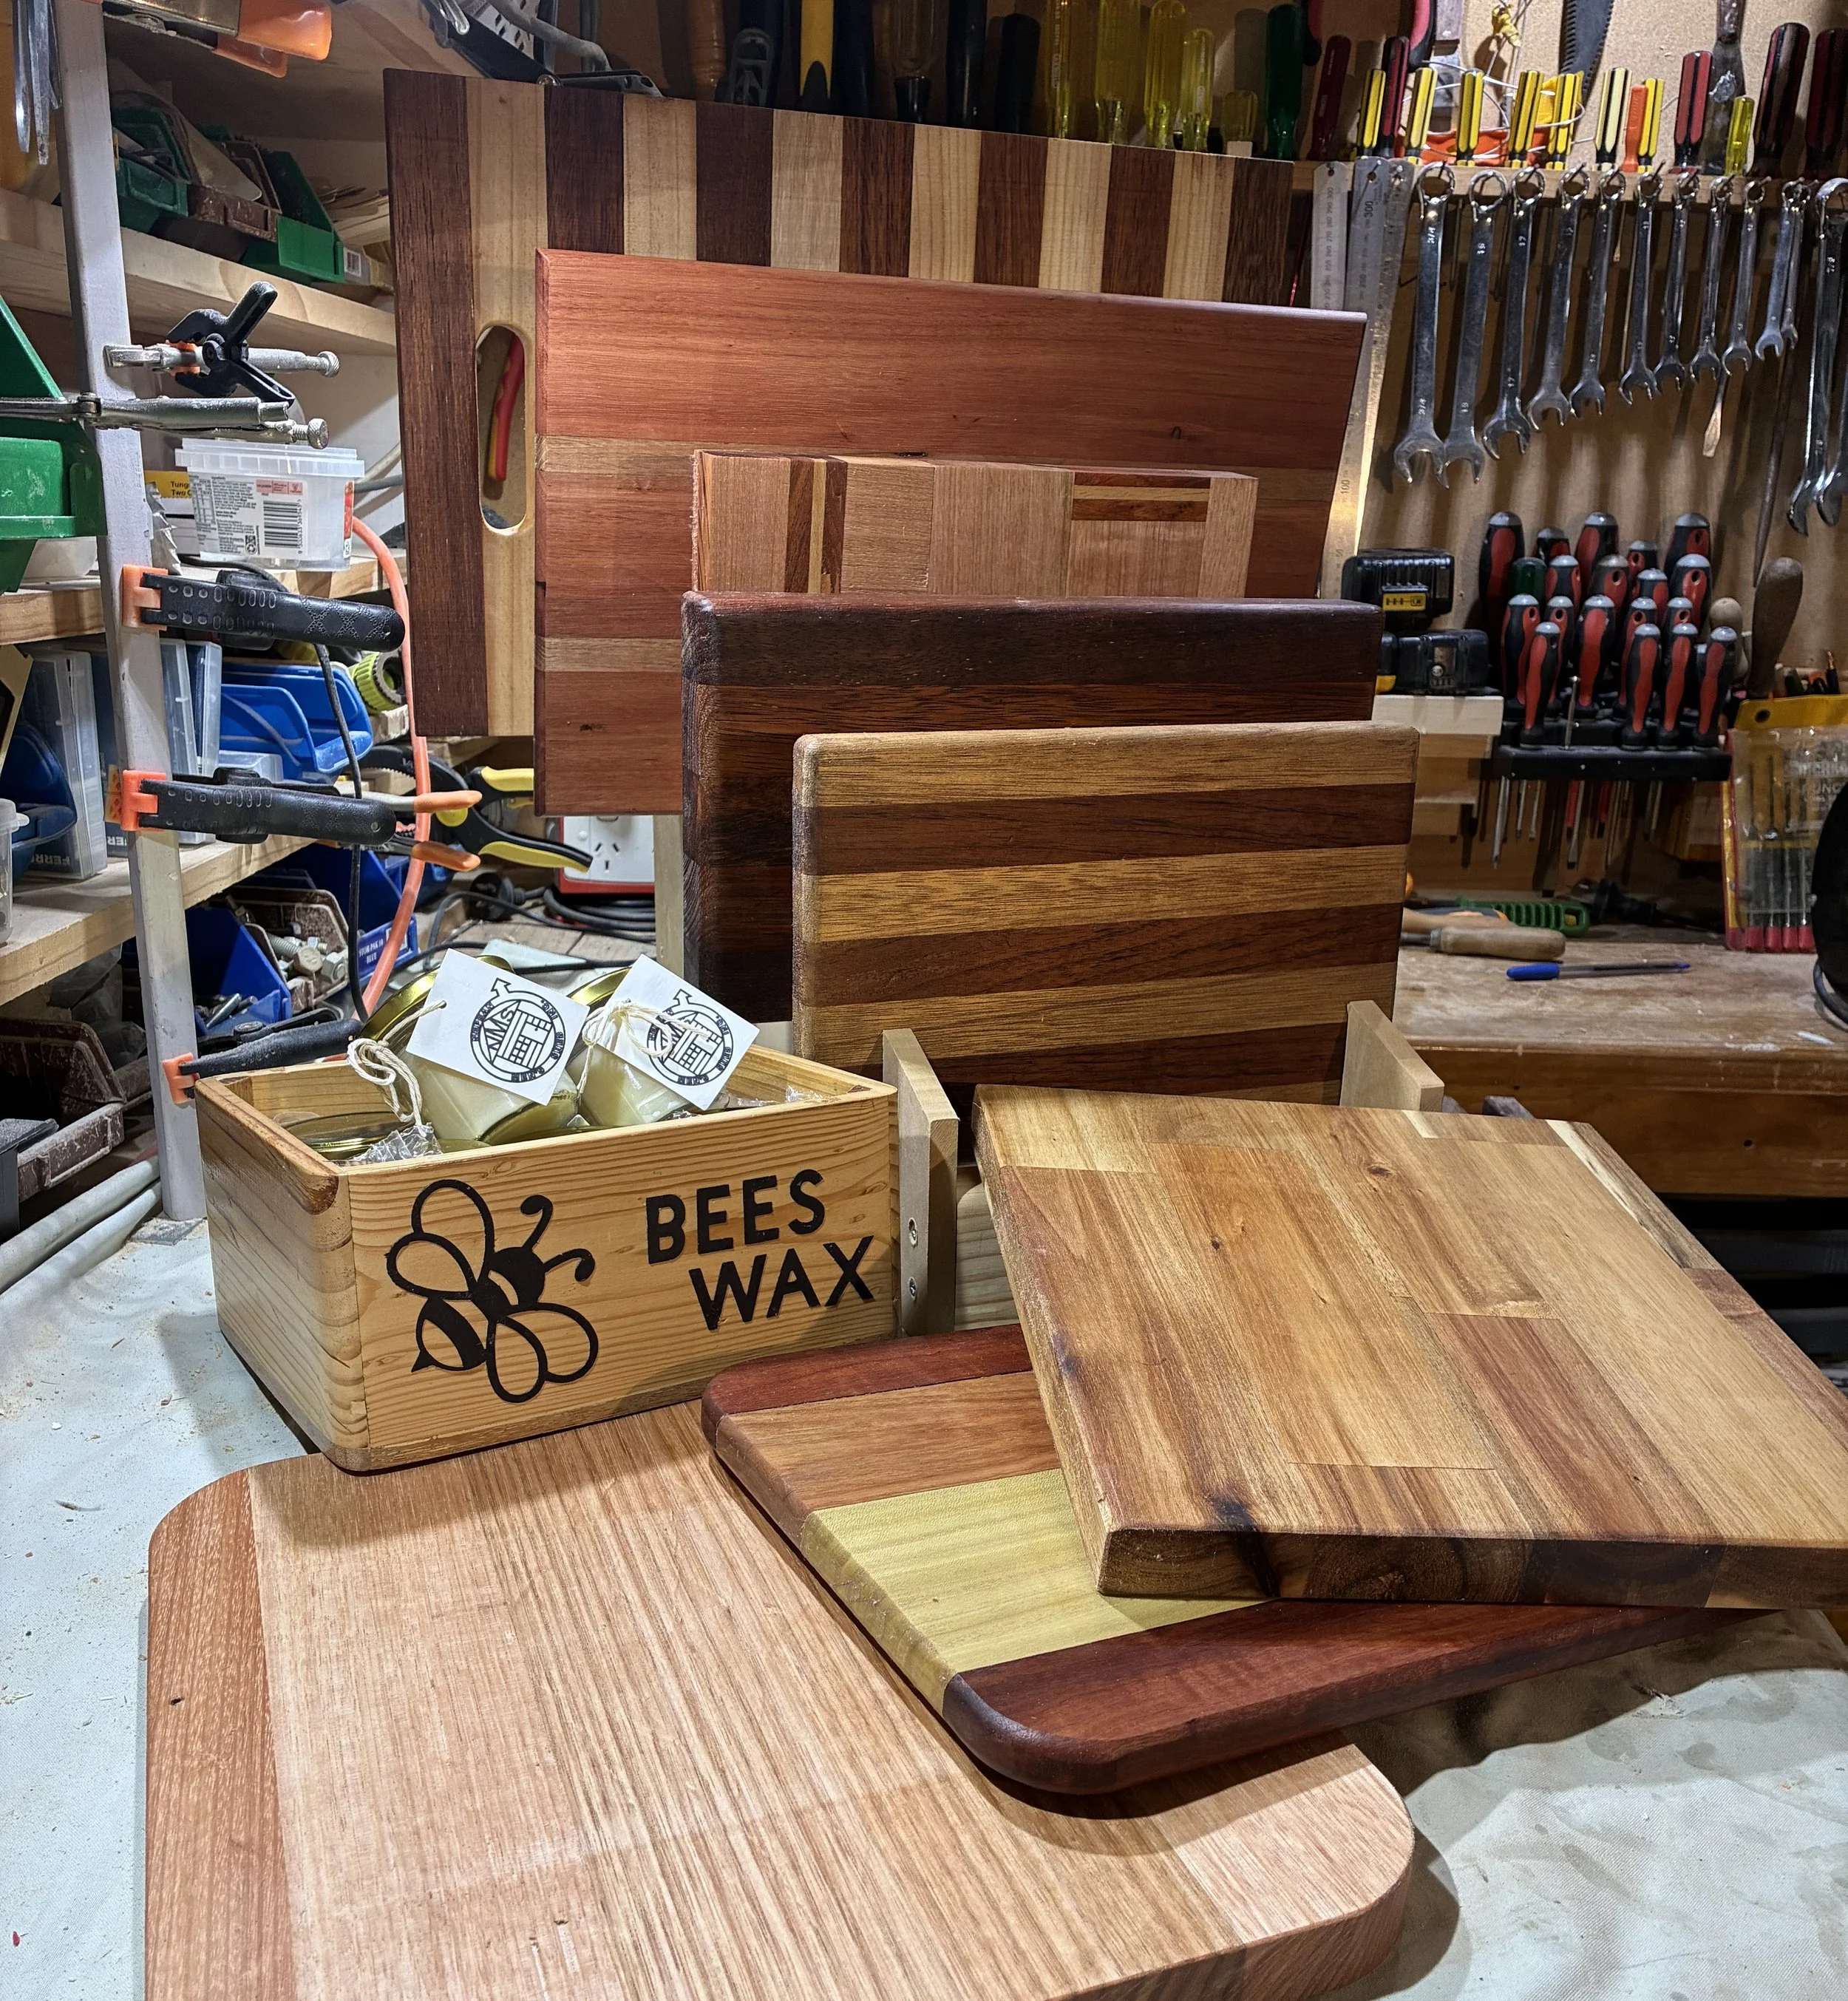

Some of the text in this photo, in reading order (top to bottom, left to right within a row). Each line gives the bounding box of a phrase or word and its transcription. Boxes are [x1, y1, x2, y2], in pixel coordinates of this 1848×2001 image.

[1363, 200, 1373, 218] 300
[1340, 479, 1351, 495] 100
[366, 952, 377, 965] BLUE
[646, 1169, 825, 1265] BEES
[689, 1235, 874, 1331] WAX
